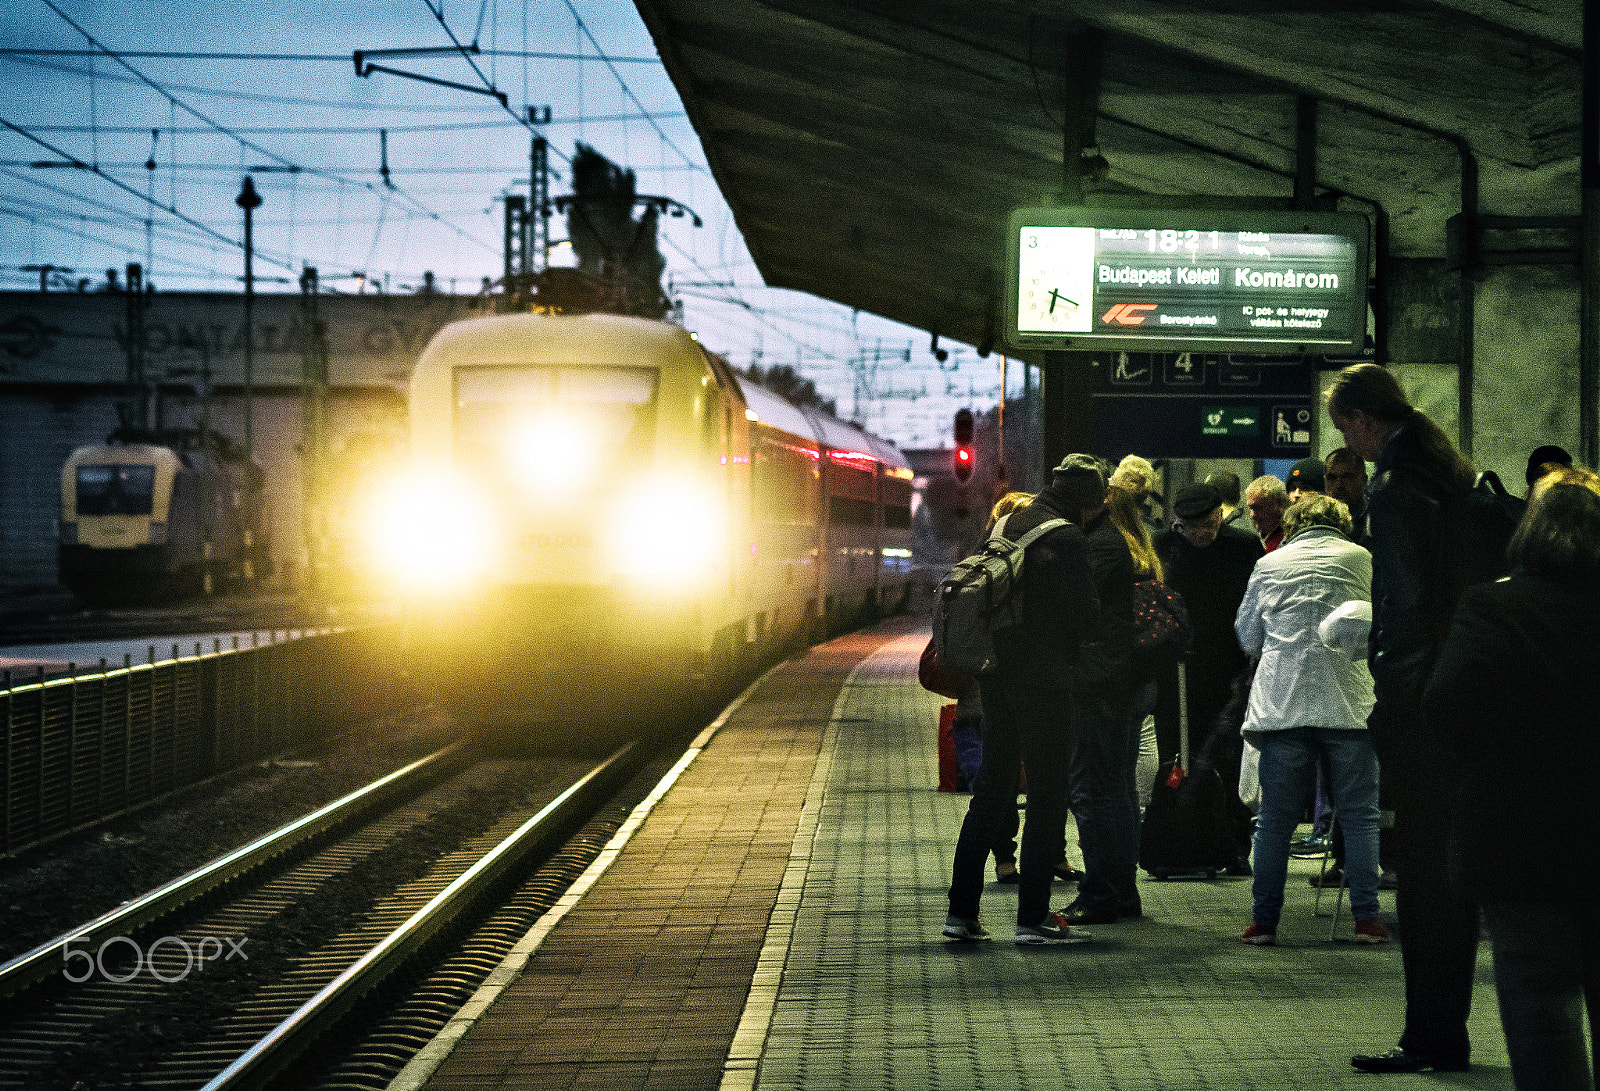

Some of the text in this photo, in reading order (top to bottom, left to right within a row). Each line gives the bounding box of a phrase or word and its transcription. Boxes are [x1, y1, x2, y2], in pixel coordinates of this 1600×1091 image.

[1028, 235, 1038, 249] 3
[1099, 265, 1220, 288] Budapest Keleti
[1235, 267, 1339, 289] Komárom
[1242, 306, 1253, 316] IC
[1174, 351, 1193, 372] 4
